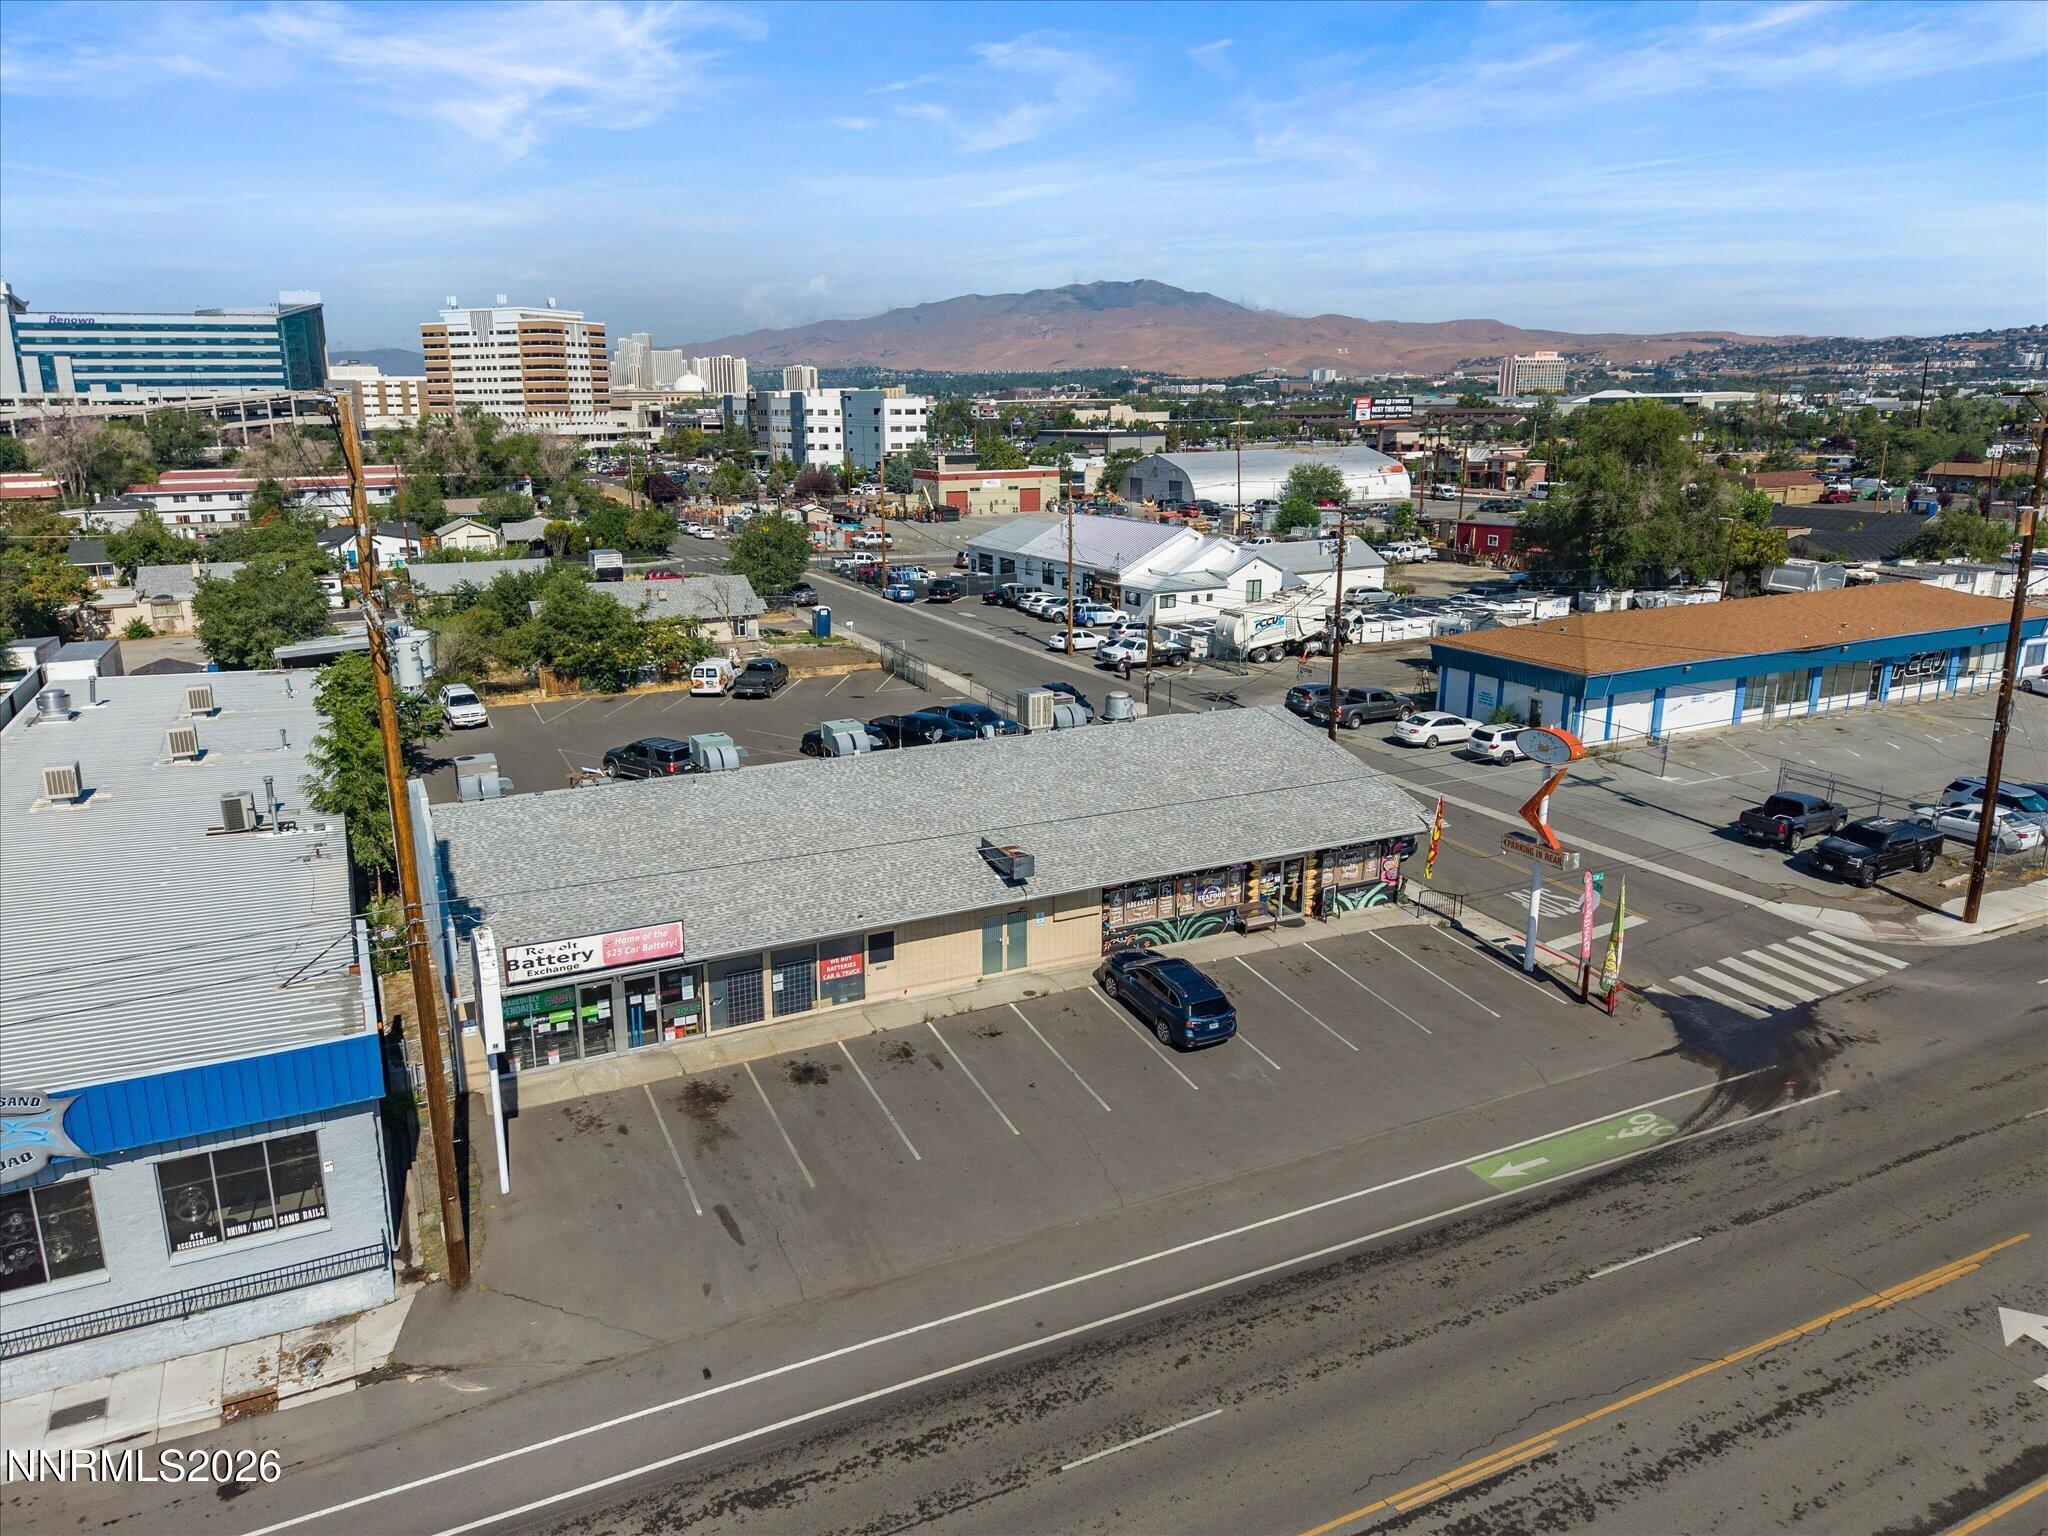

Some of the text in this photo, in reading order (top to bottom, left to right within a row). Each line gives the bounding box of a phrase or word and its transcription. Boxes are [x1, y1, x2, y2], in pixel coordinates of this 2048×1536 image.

[49, 315, 95, 324] Renown
[1507, 840, 1534, 856] PARKING
[1536, 849, 1542, 860] IN
[1197, 891, 1227, 902] SEAFOOD
[614, 929, 668, 945] Home of the
[606, 938, 678, 958] $25 Car Battery!
[508, 948, 594, 972] Battery
[826, 962, 857, 972] BATTERIES
[527, 963, 580, 977] Exchange
[842, 968, 861, 976] TRUCK
[279, 1206, 326, 1226] SAND RAILS
[177, 1235, 218, 1250] ACCESSORIES
[190, 1231, 204, 1240] ATV
